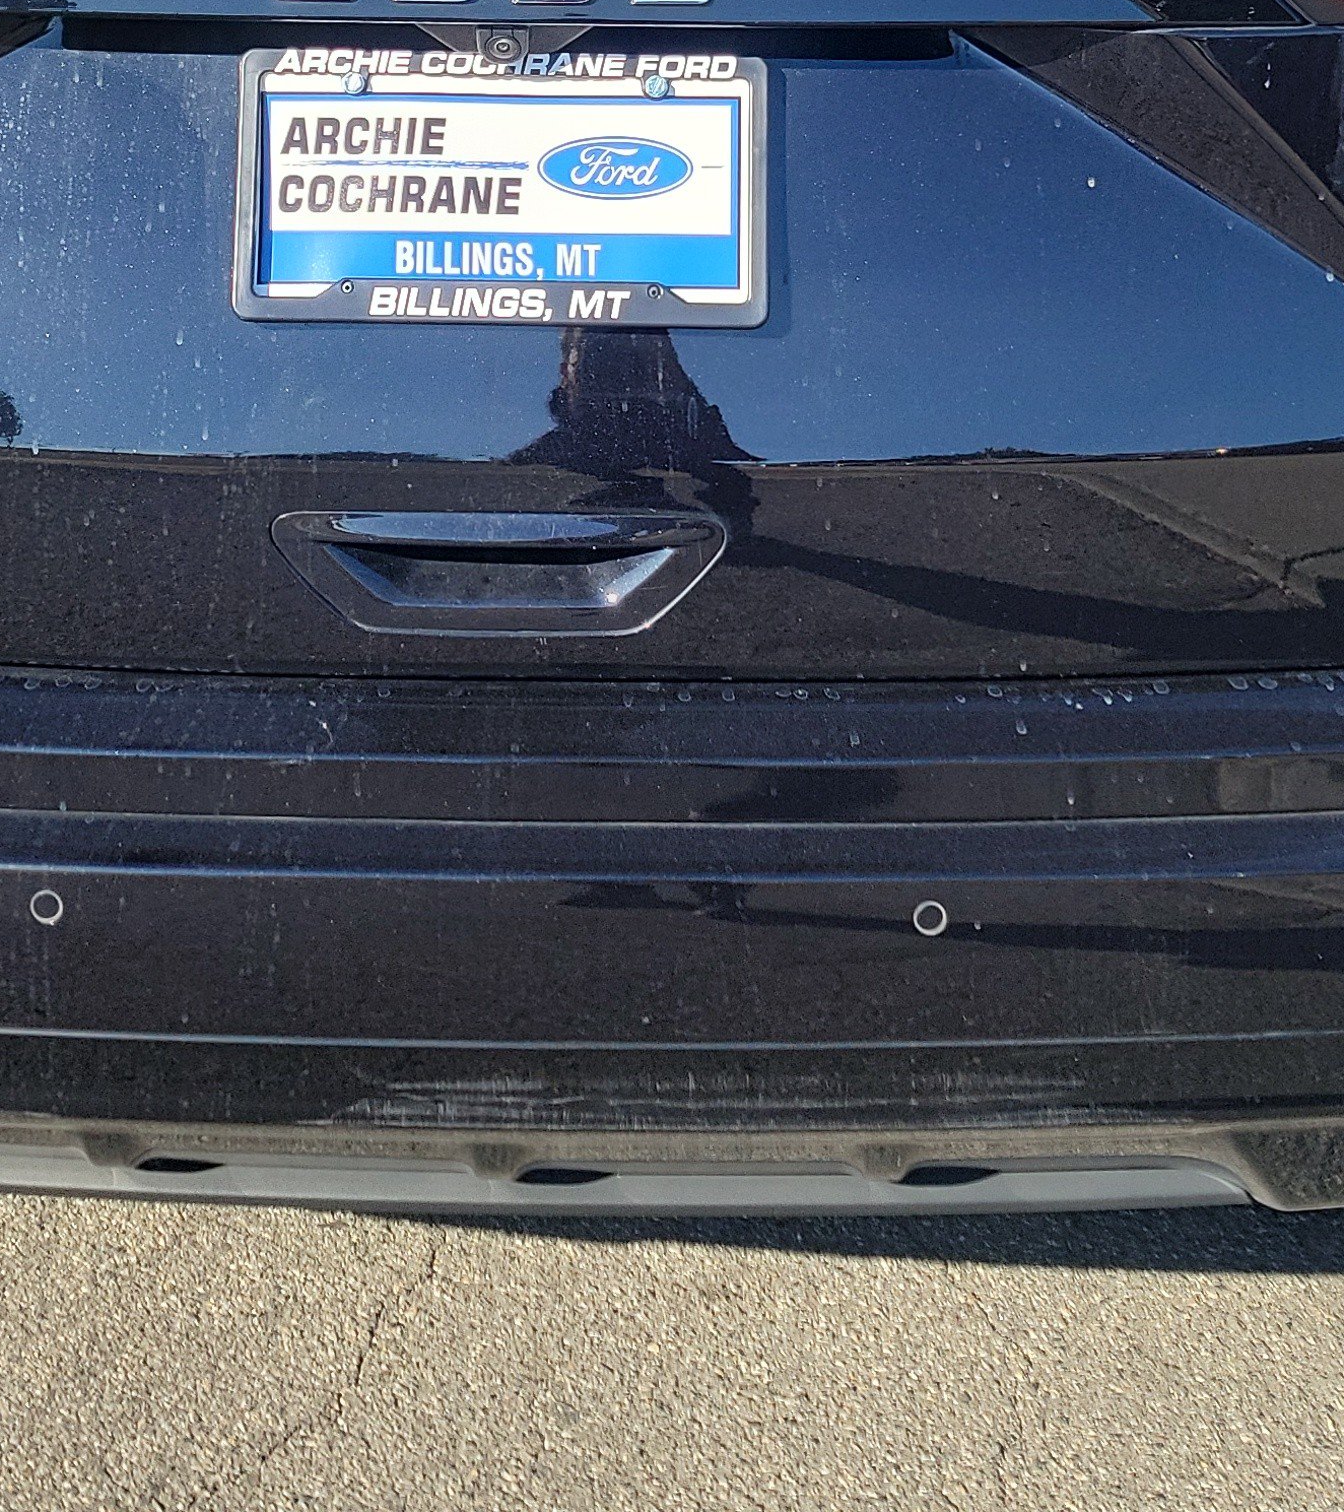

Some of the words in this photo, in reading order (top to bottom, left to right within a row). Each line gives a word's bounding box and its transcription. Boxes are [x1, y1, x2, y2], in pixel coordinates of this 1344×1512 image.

[274, 49, 413, 75] ARCHIE
[421, 50, 627, 78] COCHRANE
[635, 55, 737, 79] FORD
[280, 117, 446, 155] ARCHIE
[570, 145, 661, 186] Ford
[278, 175, 522, 214] COCHRANE
[395, 240, 544, 281] BILLINGS,
[556, 244, 601, 276] MT
[369, 286, 553, 321] BILLINGS,
[568, 290, 631, 320] MT
